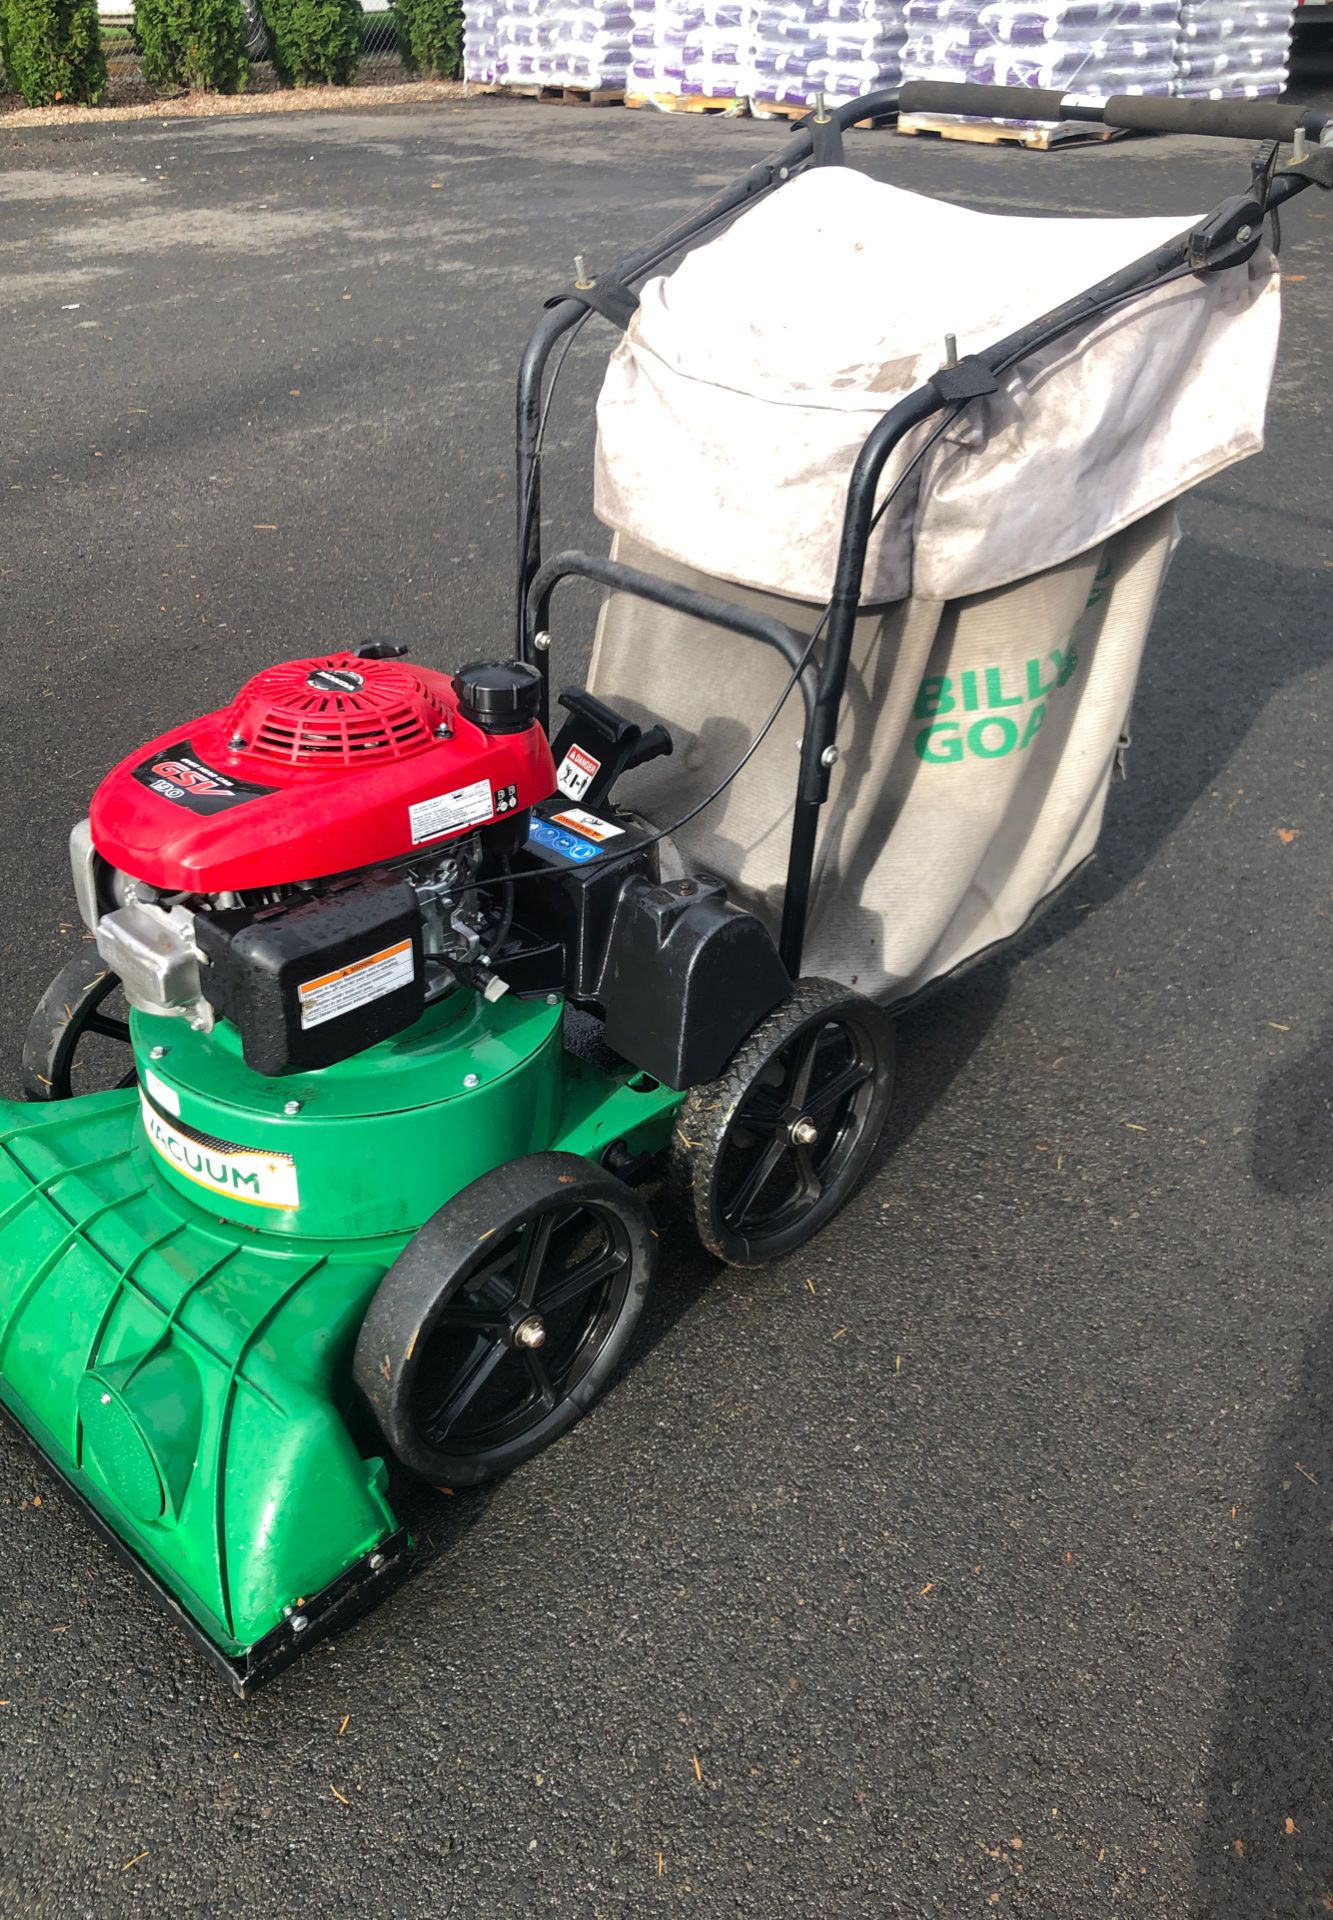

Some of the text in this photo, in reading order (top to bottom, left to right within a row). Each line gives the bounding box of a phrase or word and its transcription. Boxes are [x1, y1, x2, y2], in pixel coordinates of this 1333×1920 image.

[316, 671, 355, 691] HONDA
[914, 645, 1079, 720] BILLY
[914, 703, 1047, 764] GOA
[574, 752, 598, 775] DANGER
[149, 779, 185, 798] 190
[151, 761, 236, 796] GSV
